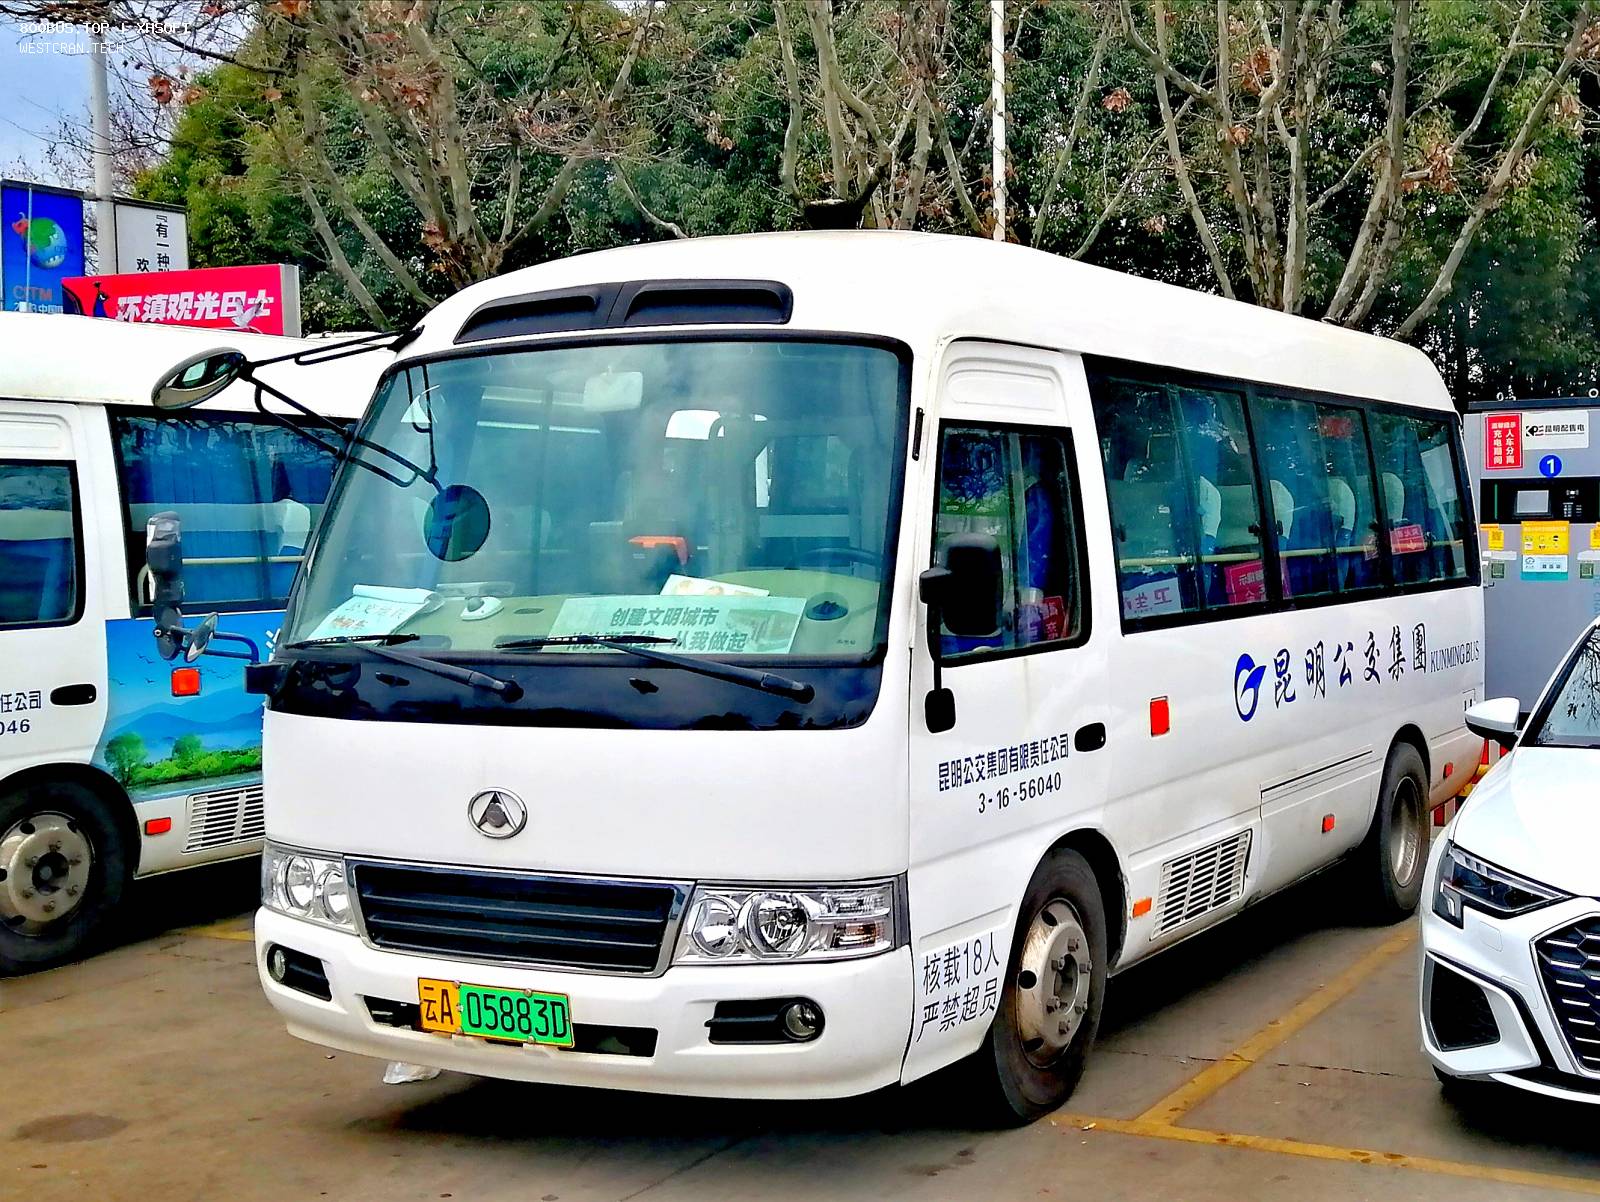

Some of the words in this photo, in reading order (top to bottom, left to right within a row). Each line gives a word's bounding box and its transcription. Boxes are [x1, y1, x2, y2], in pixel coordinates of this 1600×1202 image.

[136, 257, 150, 273] 欢
[114, 288, 275, 323] 环滇观光巴士
[1544, 423, 1585, 433] 昆明配售电
[1546, 458, 1555, 474] 1
[609, 606, 720, 629] 创建文明城市
[0, 690, 41, 713] 任公司
[938, 732, 1070, 793] 昆明公交集团有限责任公司
[922, 930, 1001, 997] 核载18人
[422, 985, 455, 1027] 云A
[465, 991, 568, 1038] 05883D
[916, 976, 999, 1043] 严禁超员
